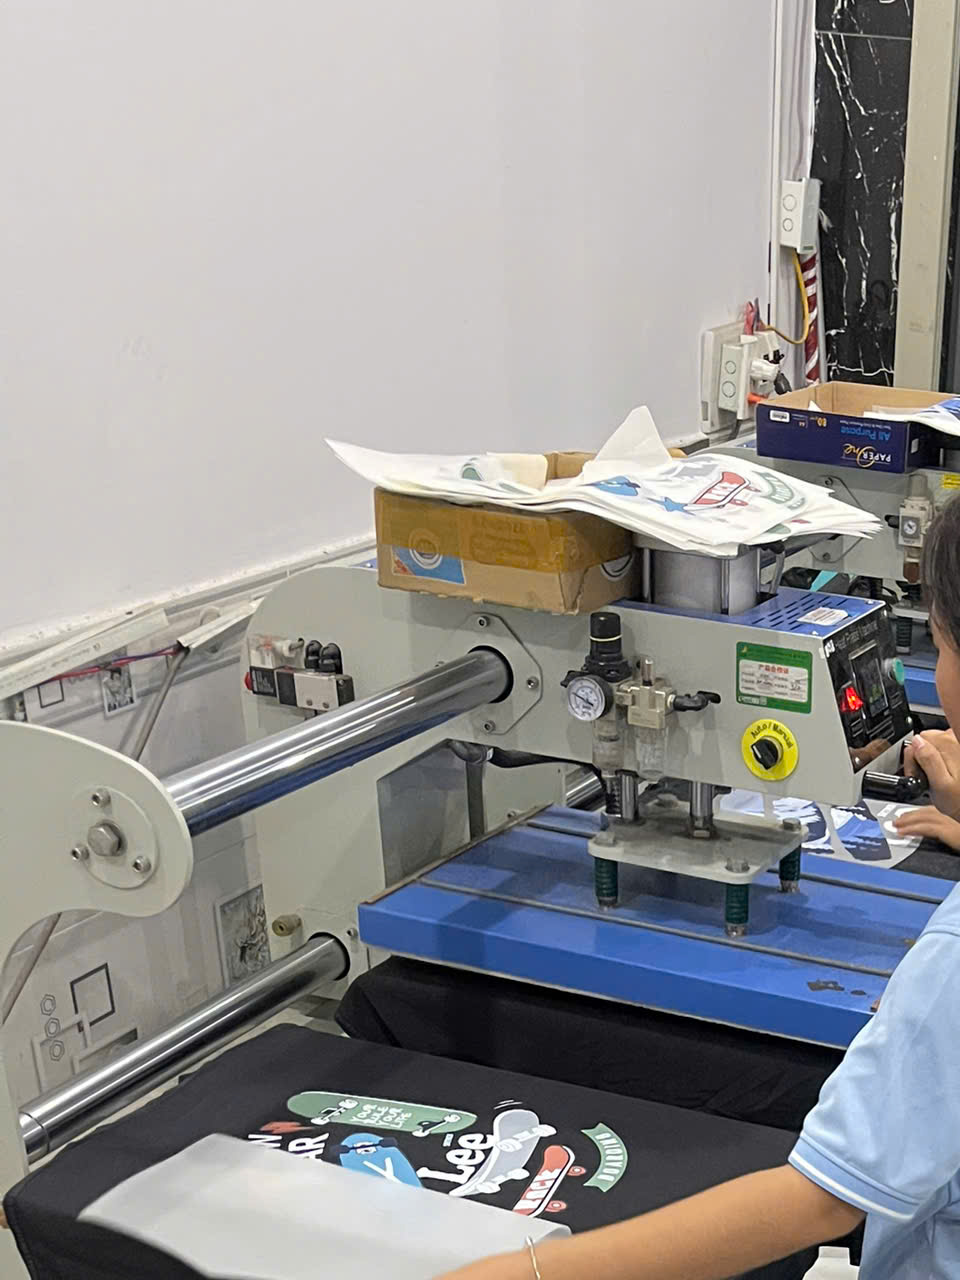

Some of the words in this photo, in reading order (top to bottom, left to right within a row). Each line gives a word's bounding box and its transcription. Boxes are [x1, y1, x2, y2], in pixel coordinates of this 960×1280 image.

[879, 431, 891, 441] All
[862, 450, 892, 462] PAPER
[750, 723, 768, 739] Auto
[773, 723, 794, 748] Manual
[416, 1131, 498, 1186] Lee
